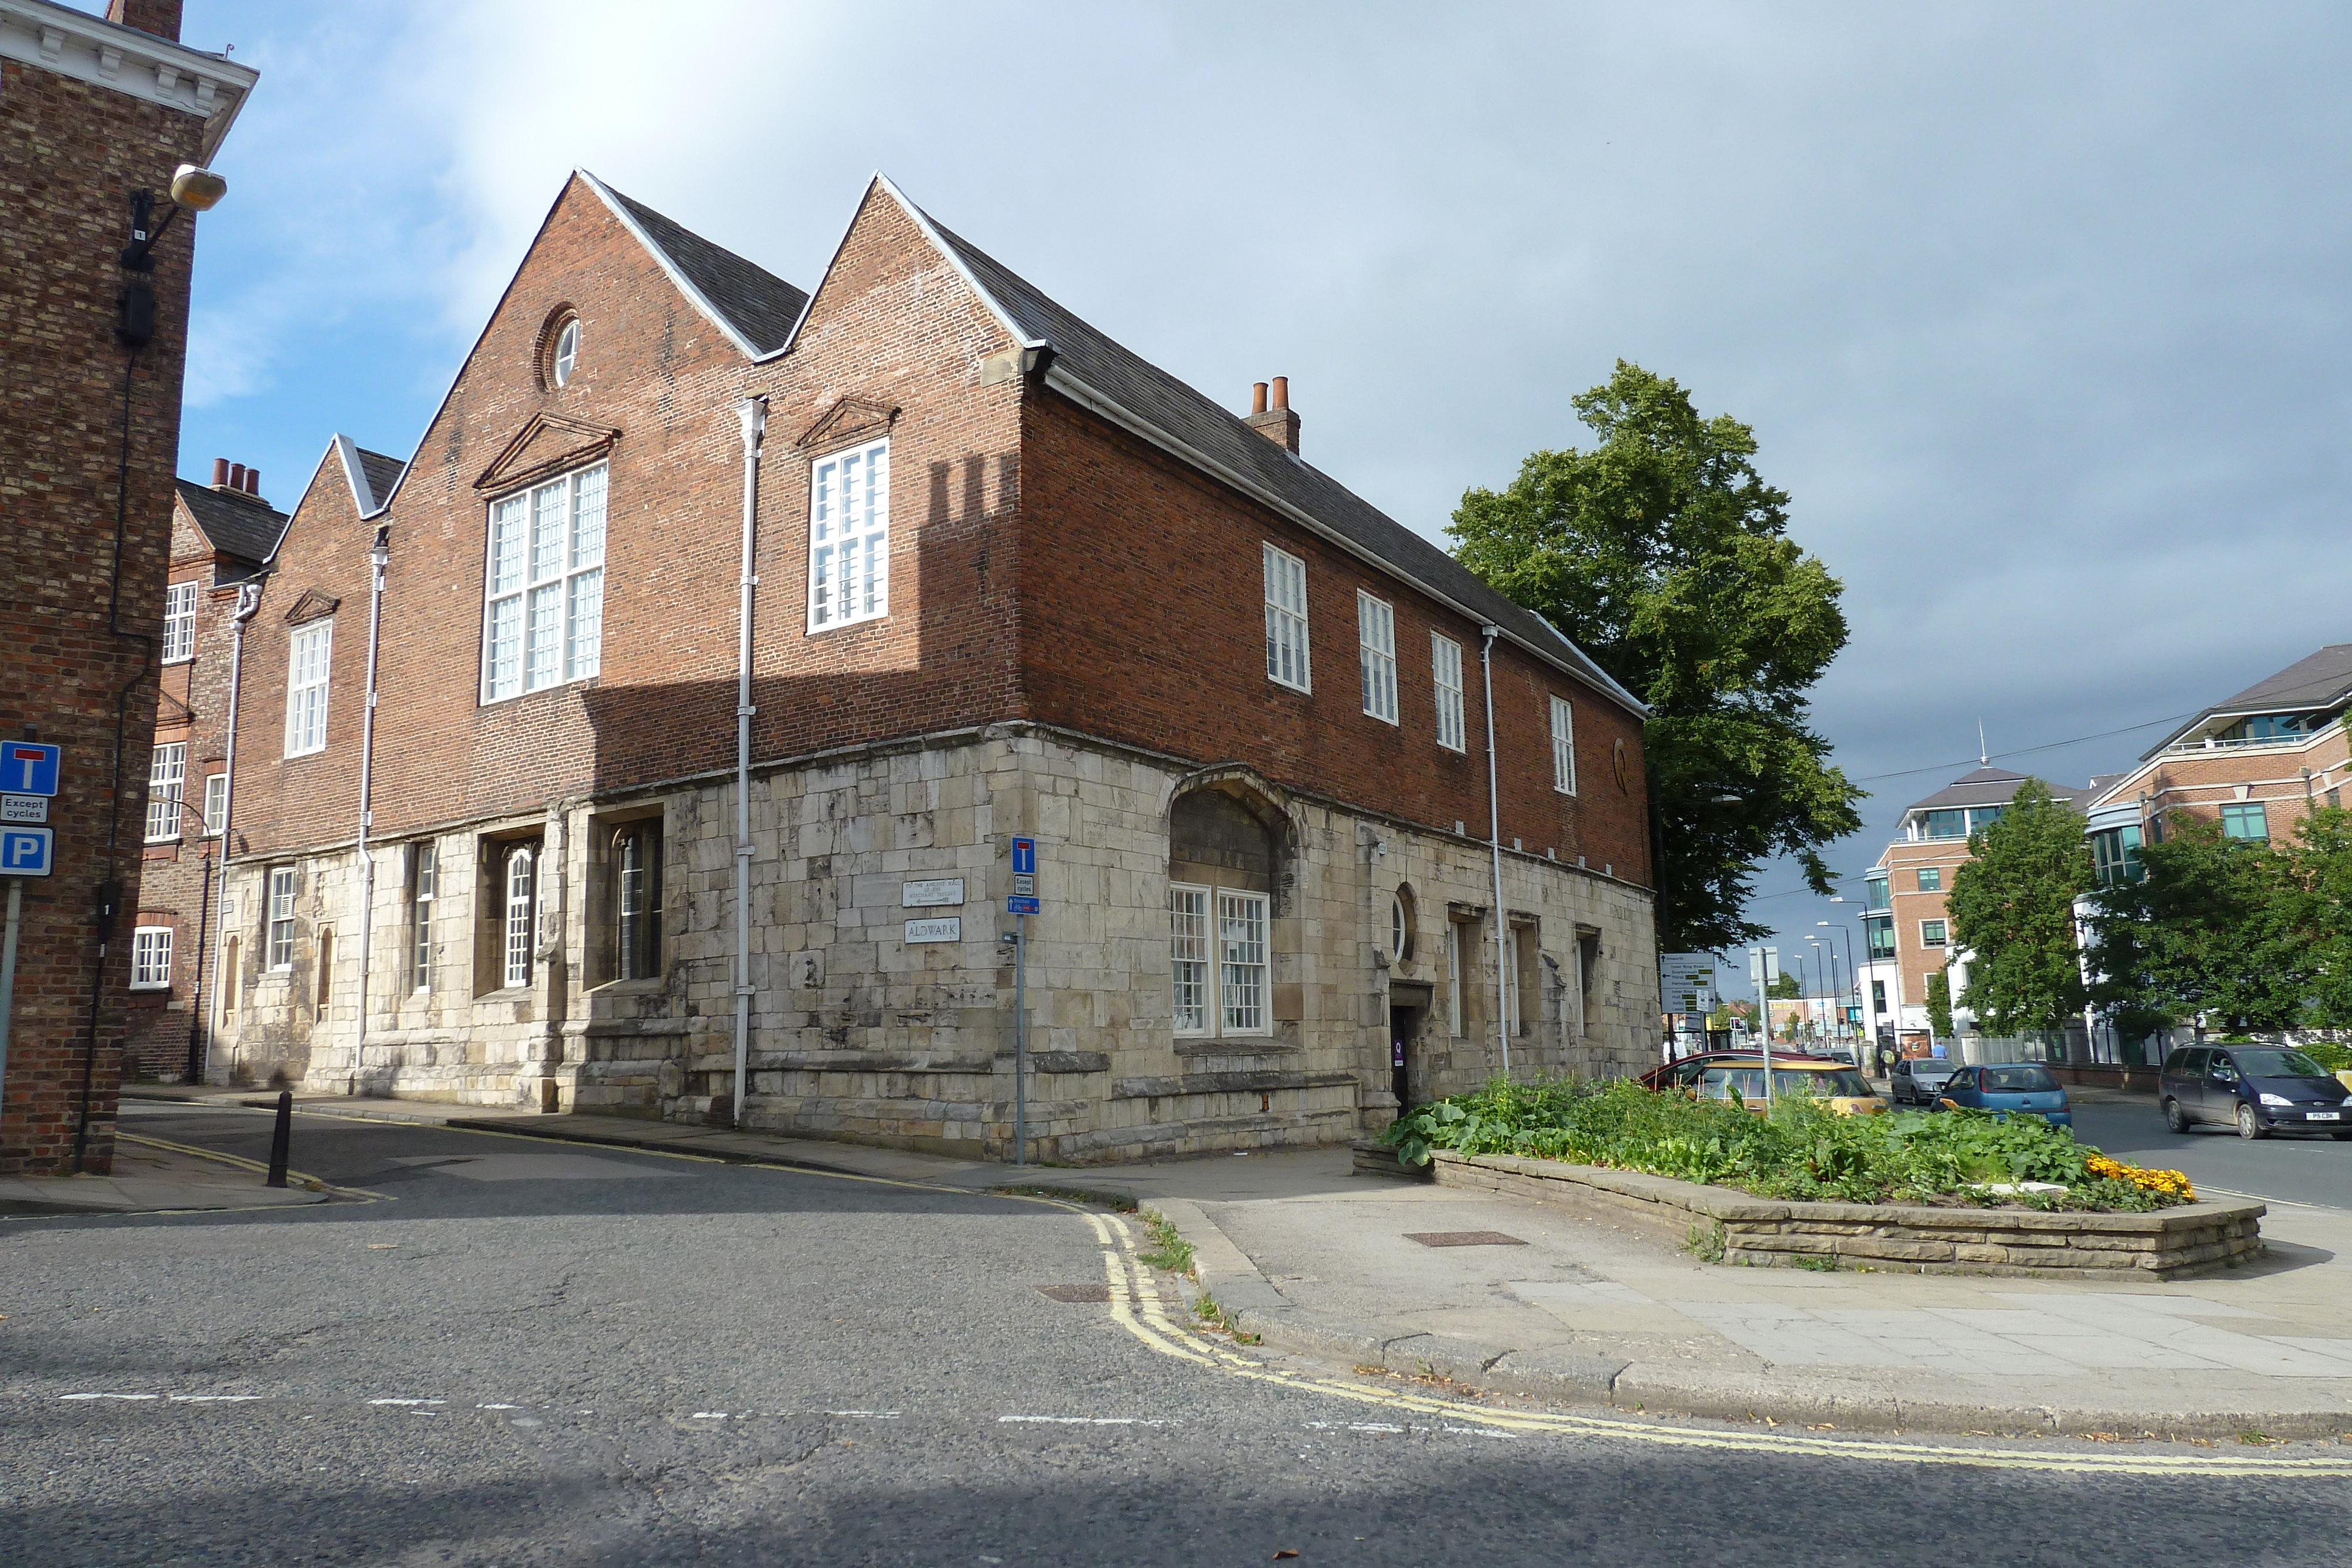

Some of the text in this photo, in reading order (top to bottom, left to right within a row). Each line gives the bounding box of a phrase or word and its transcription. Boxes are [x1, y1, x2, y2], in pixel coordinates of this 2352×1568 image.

[6, 798, 44, 809] Except
[7, 810, 41, 818] cycles
[12, 837, 39, 865] P
[104, 904, 110, 915] 1
[908, 924, 956, 936] ALDWARK
[1396, 1042, 1401, 1054] Q
